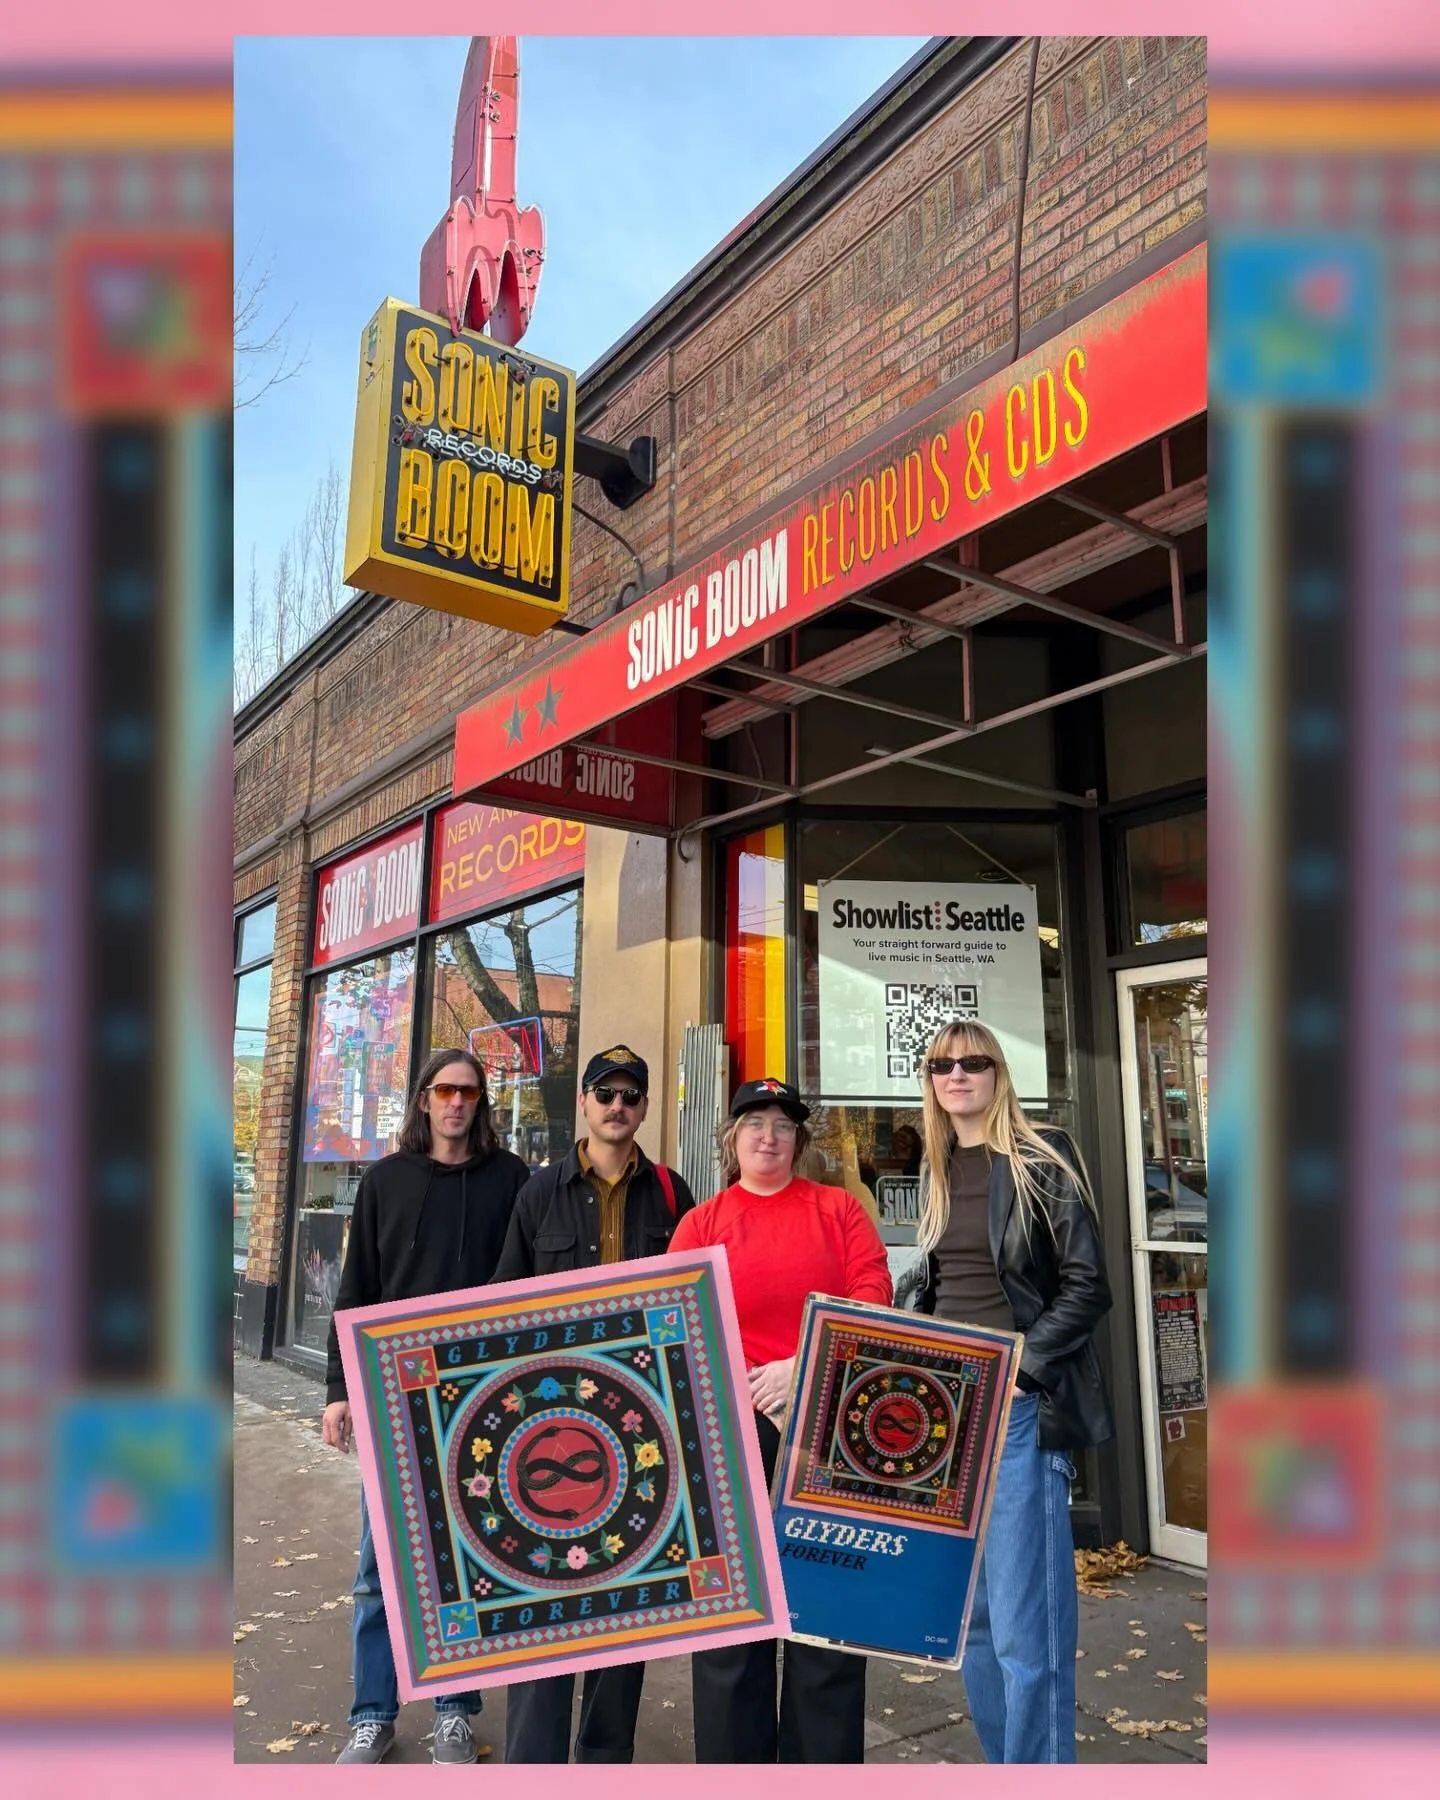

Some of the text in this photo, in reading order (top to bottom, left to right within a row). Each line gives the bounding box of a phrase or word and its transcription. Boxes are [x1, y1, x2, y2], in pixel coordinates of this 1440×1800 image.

[423, 429, 542, 485] RECORDS
[395, 450, 555, 588] BOOM
[706, 528, 788, 649] BOOM
[803, 432, 950, 595] RECORDS
[964, 409, 992, 501] &
[1006, 346, 1088, 478] CDS
[447, 806, 520, 848] NEW AN
[439, 818, 585, 898] RECORDS
[373, 837, 423, 929] BOOM
[832, 898, 1025, 932] Showlist Seattle
[853, 938, 1007, 951] Your straight forward guide to
[868, 952, 995, 964] live music in Seattle, WA
[884, 1187, 917, 1223] SON
[448, 1316, 633, 1364] GLYDERS
[780, 1542, 867, 1571] FOREVER
[784, 1516, 909, 1556] GLYDERS
[491, 1582, 680, 1631] FOREVER
